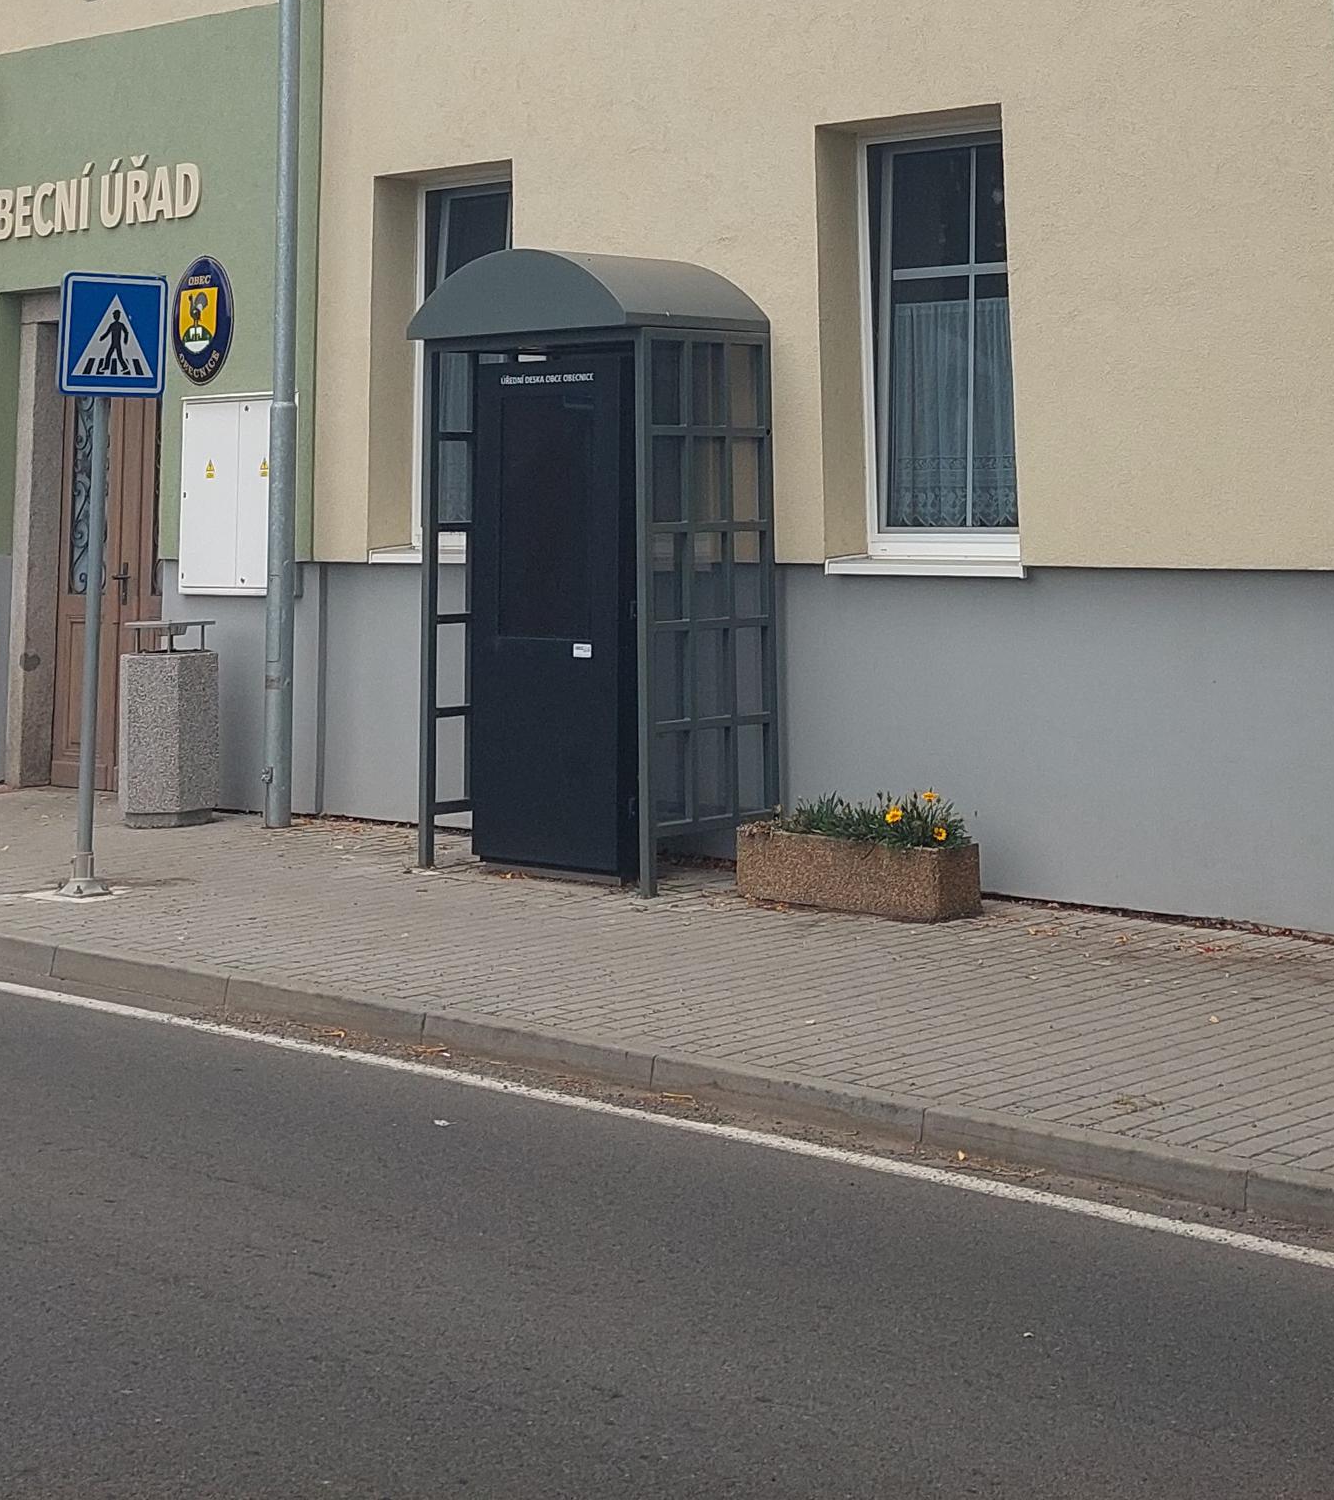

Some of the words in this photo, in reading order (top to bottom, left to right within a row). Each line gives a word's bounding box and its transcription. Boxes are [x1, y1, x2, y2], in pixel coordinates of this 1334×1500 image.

[100, 154, 201, 229] ÚŘAD
[188, 275, 211, 286] OBEC
[179, 350, 220, 378] OBECNICE
[525, 375, 544, 384] DESKA
[546, 374, 562, 383] OBCE
[563, 372, 594, 382] OBECNICE
